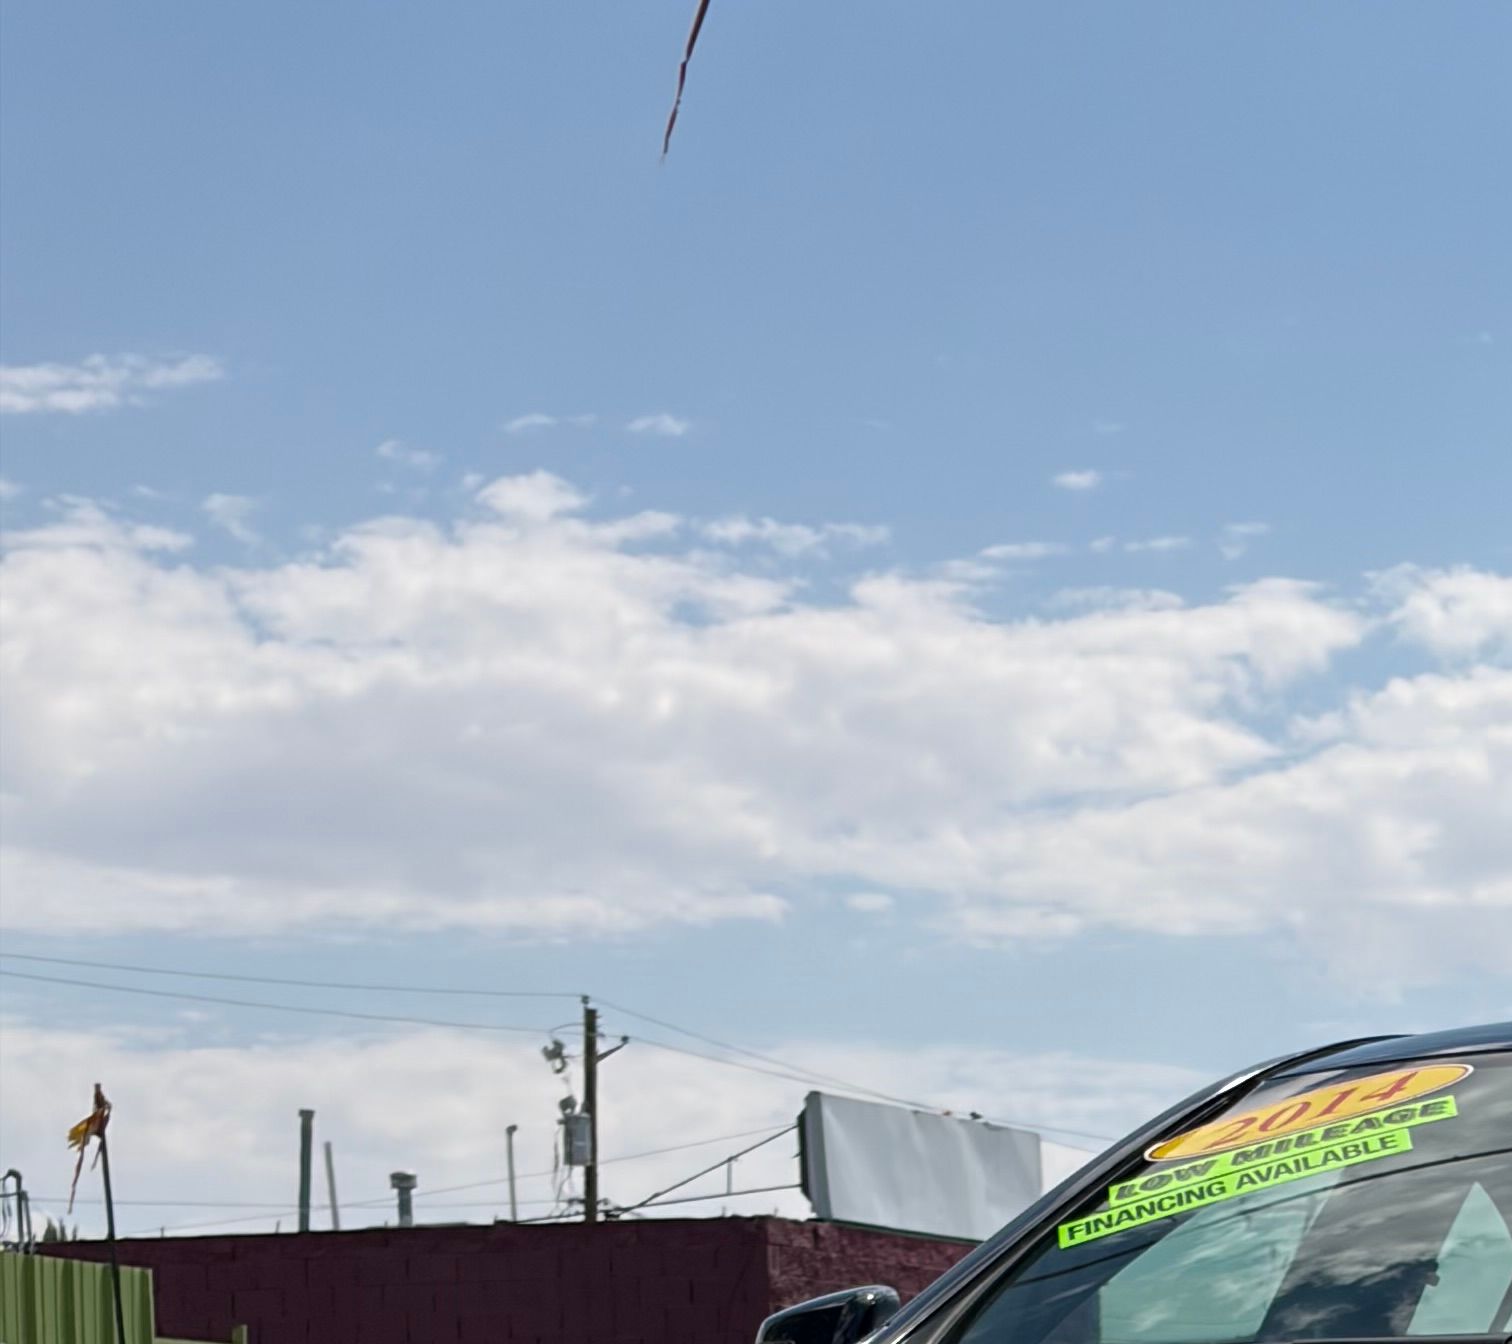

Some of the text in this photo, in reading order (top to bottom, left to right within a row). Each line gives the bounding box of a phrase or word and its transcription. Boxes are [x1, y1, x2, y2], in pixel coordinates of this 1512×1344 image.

[1115, 1101, 1450, 1200] LOW MILEAGE
[1204, 1072, 1419, 1149] 2014
[1068, 1134, 1399, 1240] FINANCING AVAILABLE
